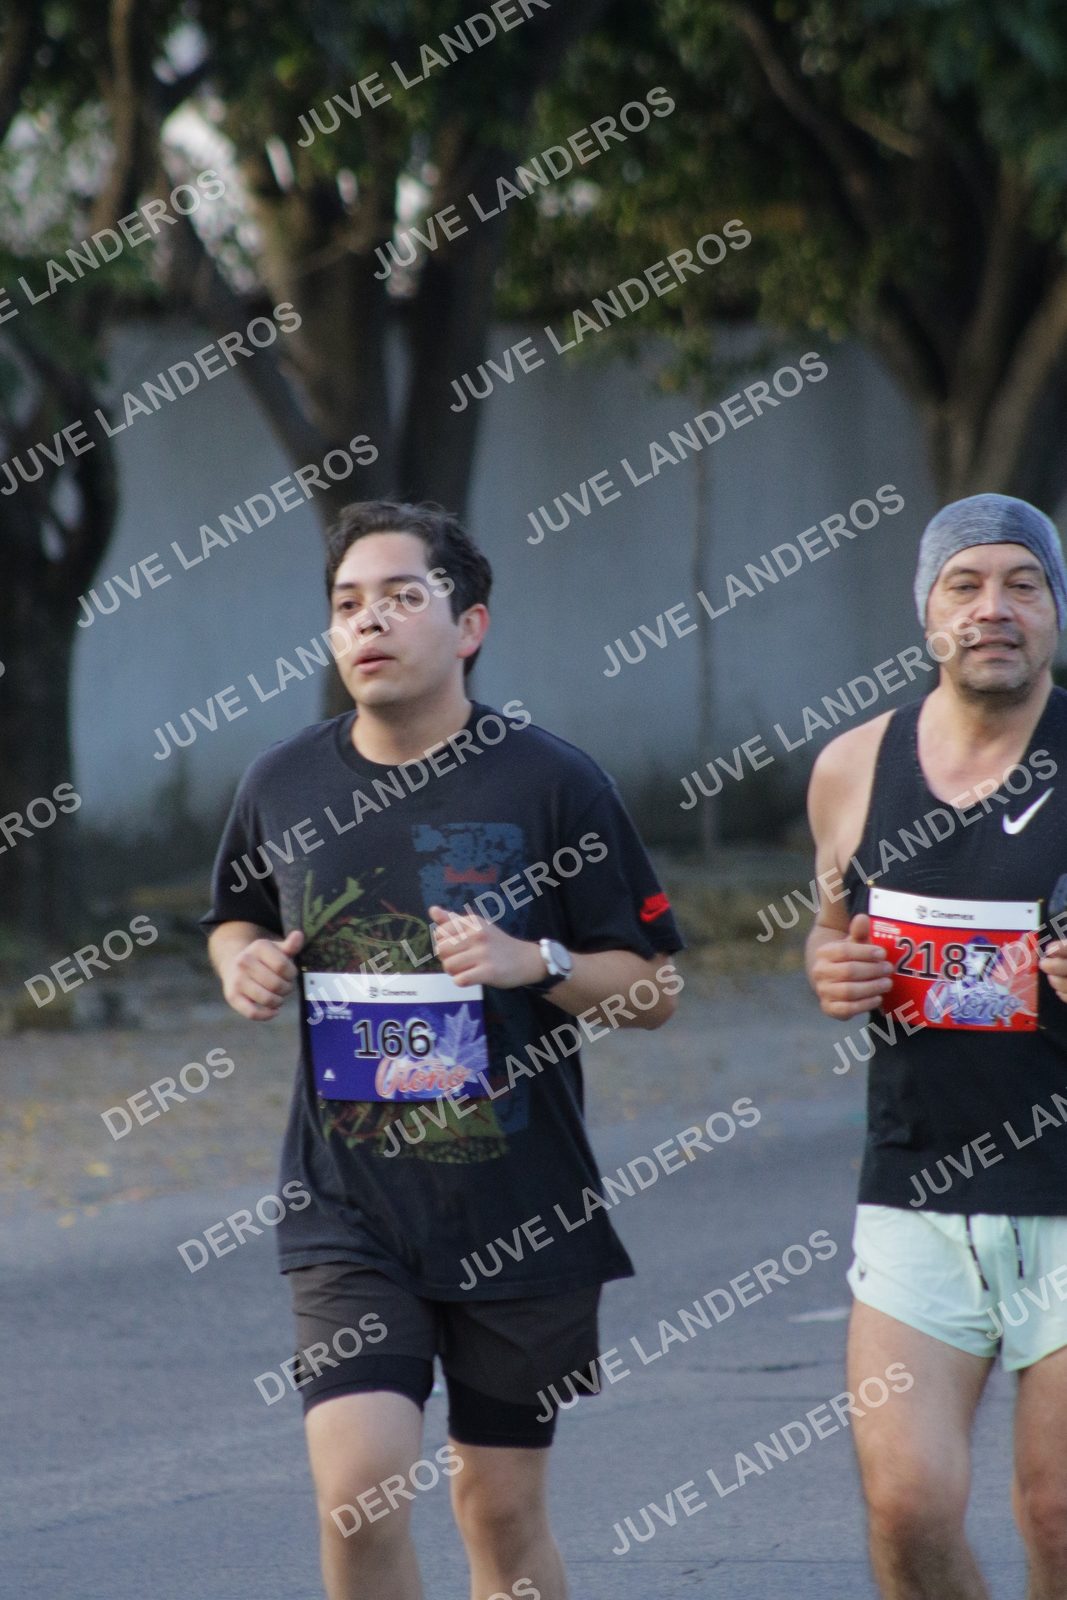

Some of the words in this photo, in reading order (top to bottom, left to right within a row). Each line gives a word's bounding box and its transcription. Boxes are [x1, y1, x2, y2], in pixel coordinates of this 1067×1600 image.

[931, 909, 976, 921] Cinemex
[895, 936, 999, 983] 2187
[353, 1019, 433, 1059] 166
